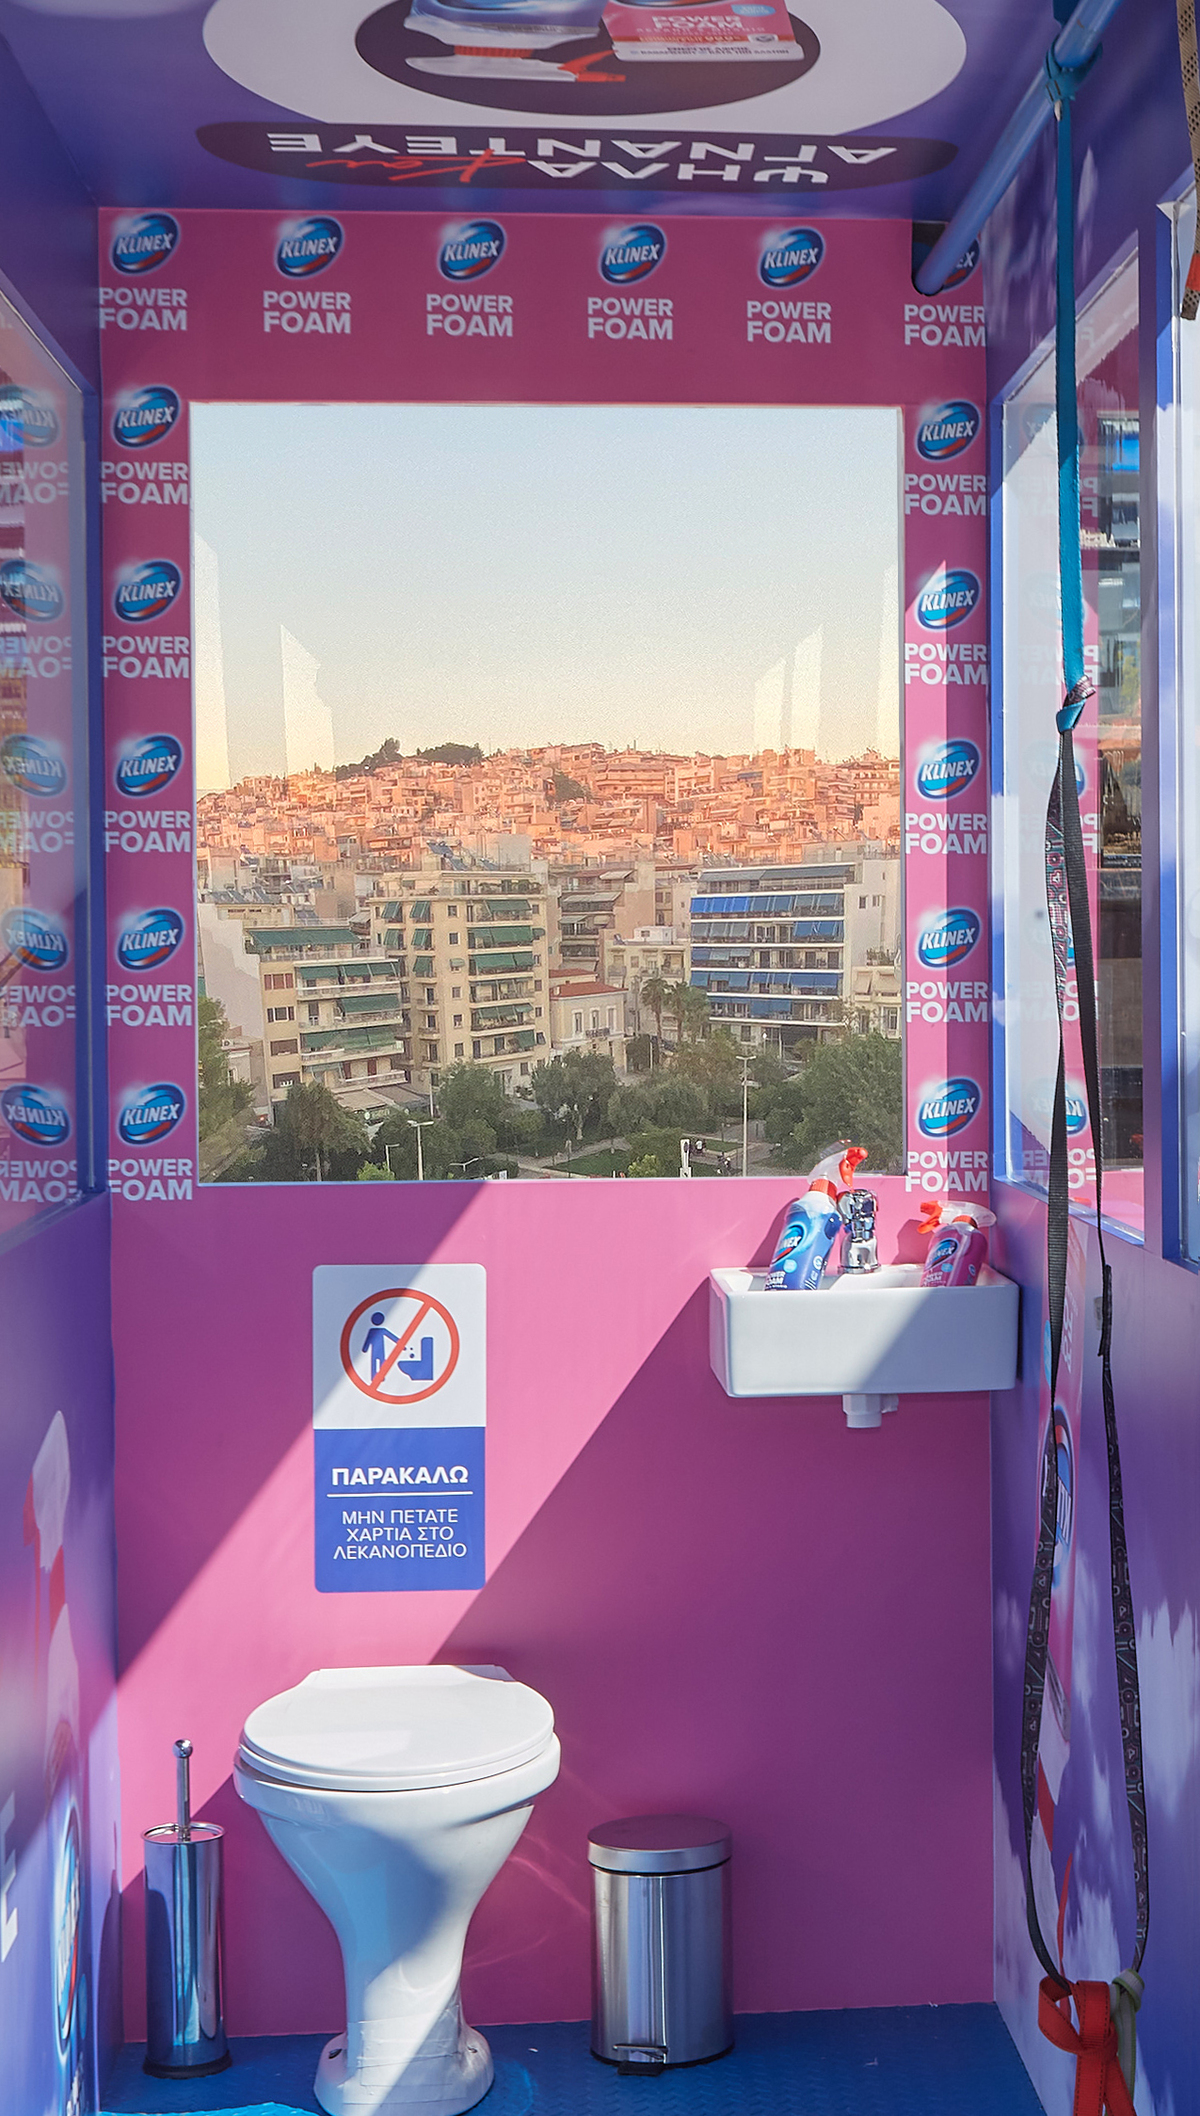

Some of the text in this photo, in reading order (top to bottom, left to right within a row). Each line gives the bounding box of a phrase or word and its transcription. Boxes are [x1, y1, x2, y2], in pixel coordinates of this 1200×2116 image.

[266, 133, 898, 165] ΑΓΝΑΝΤΕΥΕ
[526, 160, 829, 184] ΨΗΛΑ
[116, 233, 174, 256] KLINEX
[280, 236, 338, 259] KLINEX
[443, 239, 501, 262] KLINEX
[605, 243, 661, 266] KLINEX
[764, 247, 820, 269] KLINEX
[99, 288, 187, 307] POWER
[263, 291, 351, 310] POWER
[426, 294, 513, 313] POWER
[587, 298, 673, 317] POWER
[100, 308, 187, 330] FOAM
[747, 301, 831, 320] POWER
[904, 304, 985, 323] POWER
[264, 311, 351, 333] FOAM
[427, 314, 513, 336] FOAM
[588, 318, 673, 340] FOAM
[747, 321, 831, 343] FOAM
[904, 324, 986, 346] FOAM
[117, 405, 175, 429] KLINEX
[921, 419, 975, 443] KLINEX
[101, 461, 188, 480] POWER
[101, 482, 188, 504] FOAM
[905, 474, 986, 492] POWER
[905, 494, 986, 516] FOAM
[119, 579, 176, 603] KLINEX
[921, 588, 975, 611] KLINEX
[103, 636, 189, 654] POWER
[905, 643, 987, 661] POWER
[103, 657, 189, 678] FOAM
[905, 664, 987, 685] FOAM
[120, 753, 178, 778] KLINEX
[921, 757, 975, 780] KLINEX
[105, 811, 191, 828] POWER
[906, 813, 987, 831] POWER
[105, 831, 191, 852] FOAM
[906, 833, 987, 854] FOAM
[122, 927, 179, 951] KLINEX
[921, 928, 975, 949] KLINEX
[107, 985, 192, 1002] POWER
[907, 982, 988, 999] POWER
[107, 1005, 192, 1026] FOAM
[907, 1002, 988, 1023] FOAM
[123, 1102, 180, 1127] KLINEX
[921, 1097, 976, 1118] KLINEX
[109, 1159, 192, 1177] POWER
[908, 1149, 988, 1168] POWER
[109, 1179, 193, 1201] FOAM
[906, 1171, 987, 1192] FOAM
[332, 1466, 468, 1486] ΠΑΡΑΚΑΛΩ
[342, 1509, 458, 1525] ΜΗΝ ΠΕΤΑΤΕ
[346, 1527, 454, 1542] ΧΑΡΤΙΑ ΣΤΟ
[333, 1543, 467, 1559] ΛΕΚΑΝΟΠΕΔΙΟ
